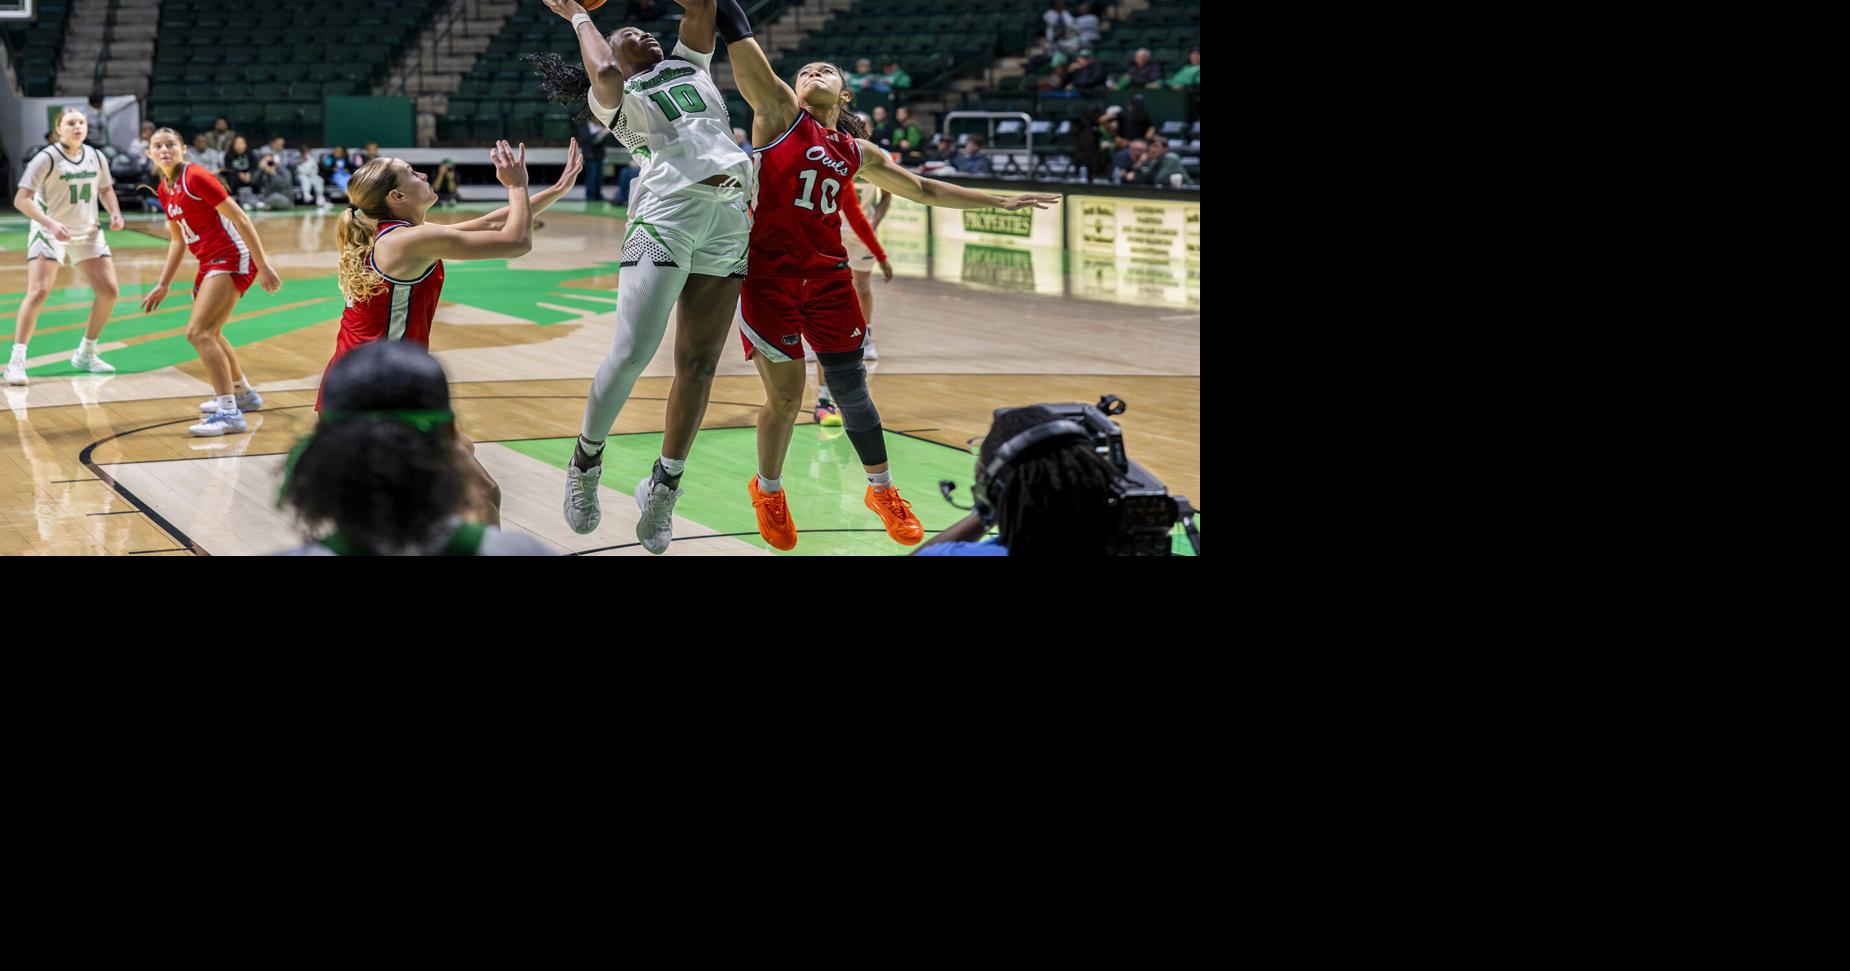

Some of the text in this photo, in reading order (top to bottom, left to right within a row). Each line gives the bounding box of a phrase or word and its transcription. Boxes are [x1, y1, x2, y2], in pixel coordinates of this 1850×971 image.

[648, 83, 707, 122] 10
[805, 145, 849, 176] Owls
[69, 183, 91, 204] 14
[794, 168, 840, 215] 10
